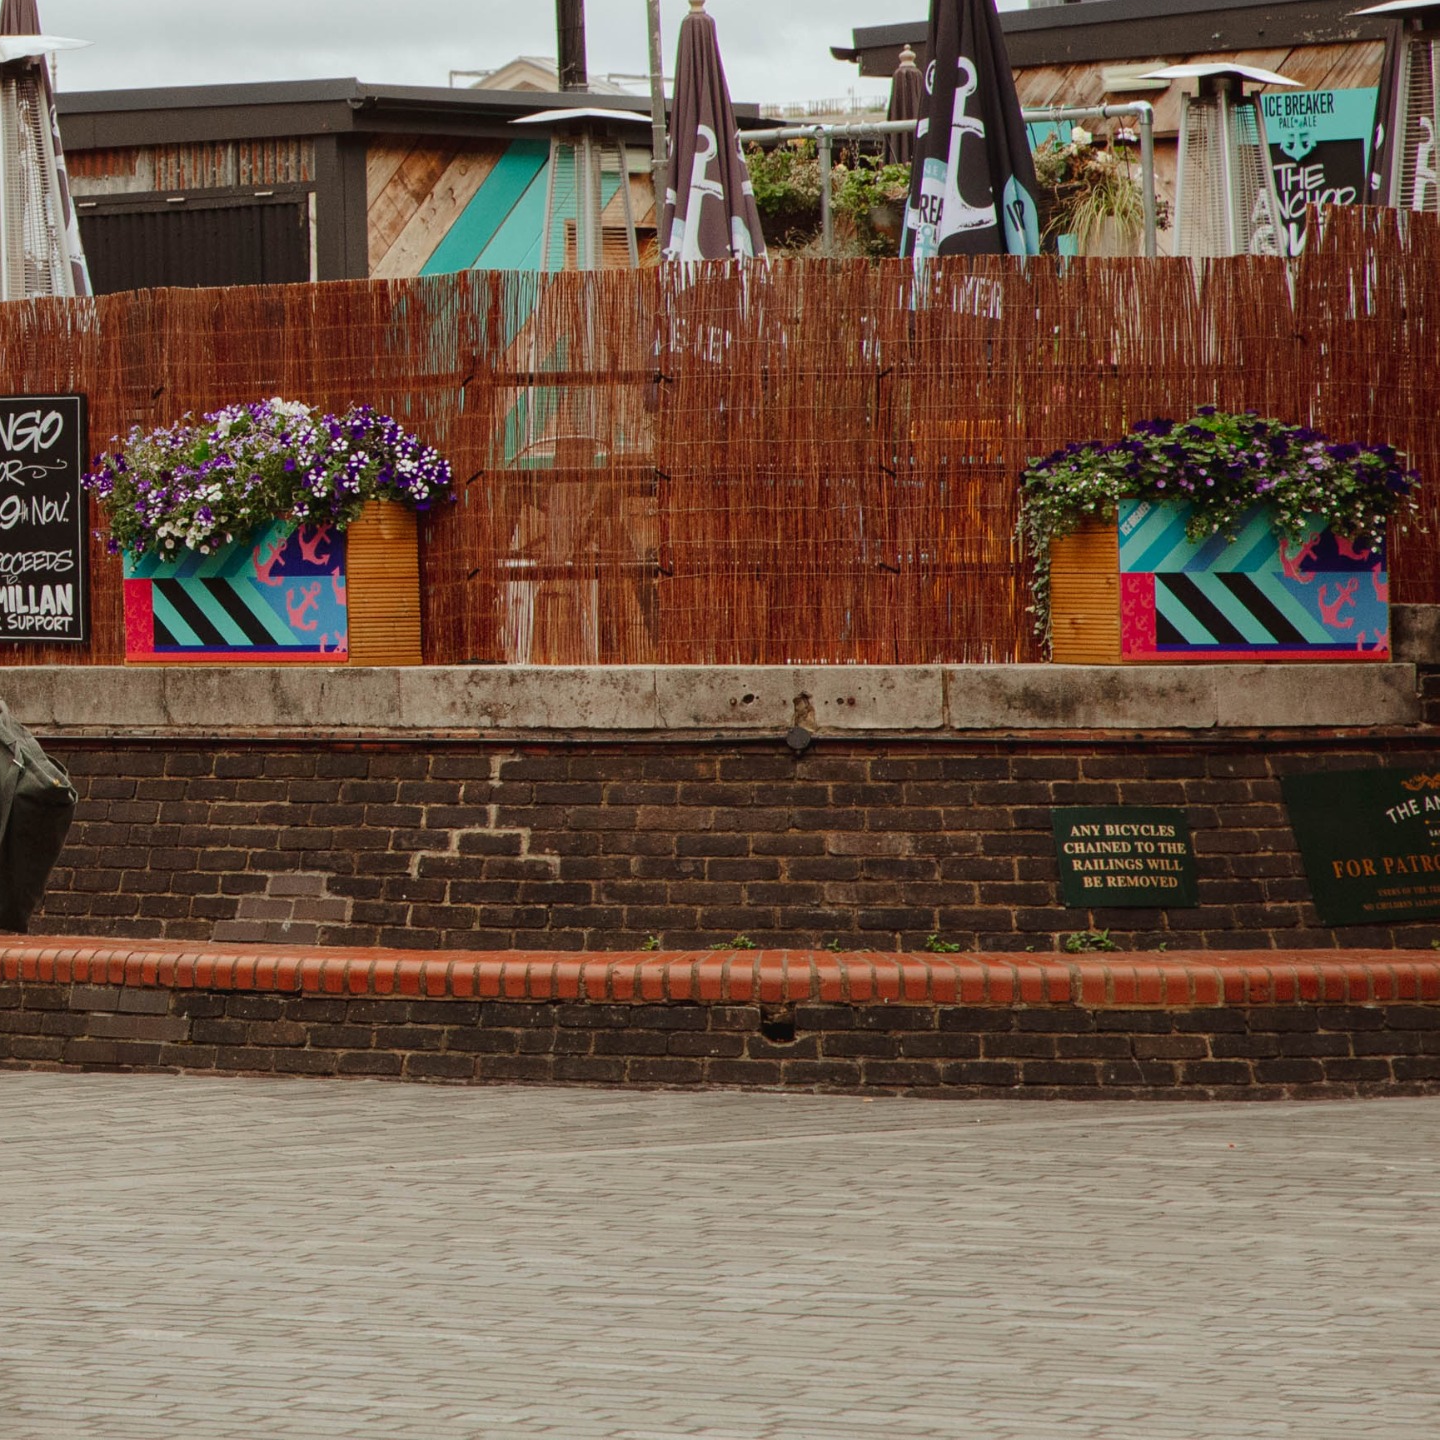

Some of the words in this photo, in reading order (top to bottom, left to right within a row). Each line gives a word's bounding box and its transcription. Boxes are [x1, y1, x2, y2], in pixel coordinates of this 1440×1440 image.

[1264, 95, 1282, 117] ICE
[1285, 92, 1334, 117] BREAKER
[1278, 116, 1295, 129] PALE
[1303, 115, 1317, 127] ALE
[1273, 163, 1326, 191] THE
[7, 614, 73, 632] SUPPORT
[1386, 799, 1421, 824] THE
[1070, 824, 1100, 837] ANY
[1104, 824, 1176, 837] BICYCLES
[1063, 841, 1132, 854] CHAINED
[1134, 841, 1155, 854] TO
[1157, 842, 1187, 855] THE
[1072, 858, 1144, 871] RAILINGS
[1146, 859, 1183, 871] WILL
[1332, 858, 1377, 879] FOR
[1082, 876, 1104, 888] BE
[1105, 875, 1178, 888] REMOVED
